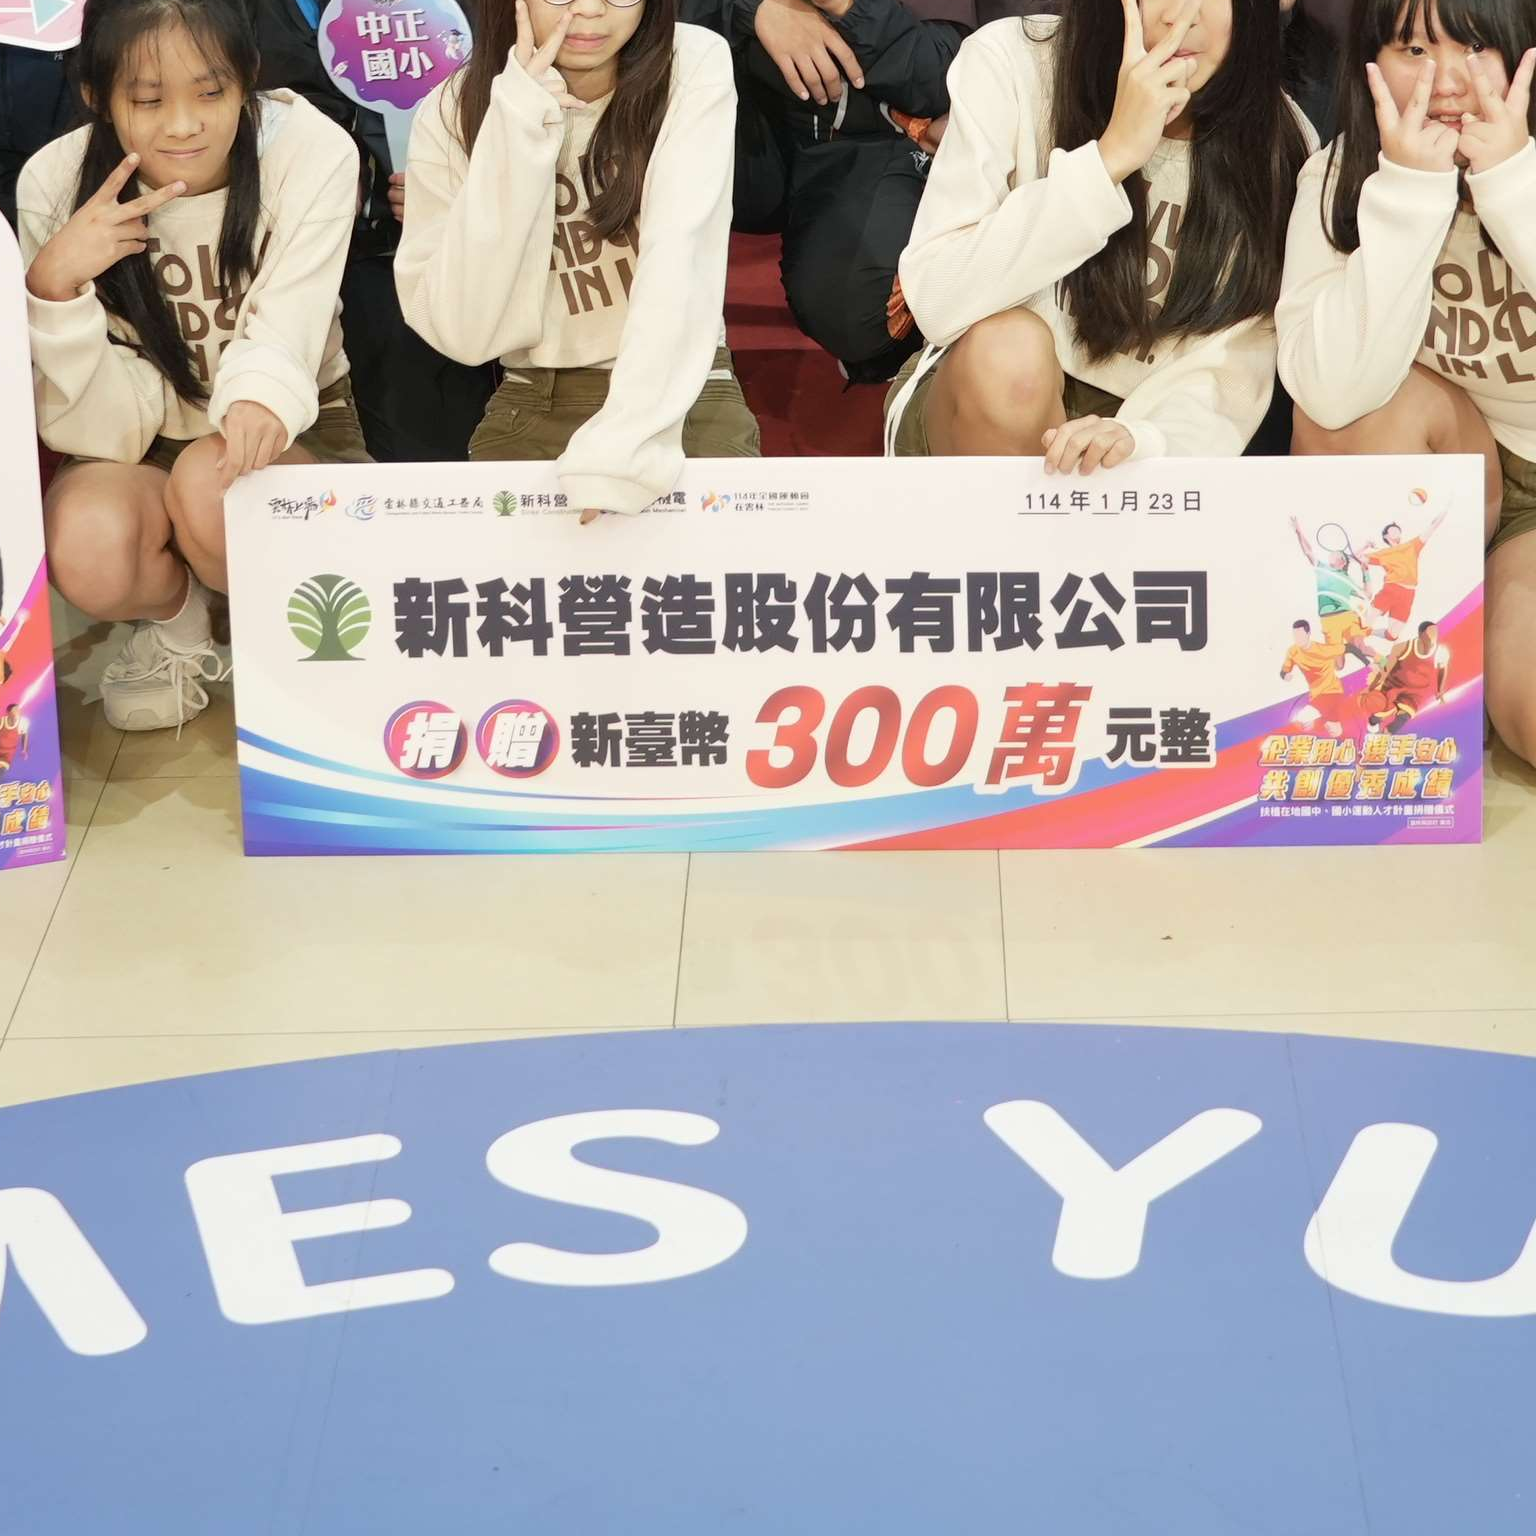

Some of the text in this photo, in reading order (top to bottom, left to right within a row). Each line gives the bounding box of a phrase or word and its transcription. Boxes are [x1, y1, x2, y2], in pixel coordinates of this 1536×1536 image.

[355, 9, 430, 44] 中正
[361, 47, 434, 82] 國小
[1025, 490, 1202, 512] 114 年 1 月 23 日
[393, 570, 1208, 659] 新科營造股份有限公司
[570, 710, 730, 769] 新臺幣
[744, 681, 1093, 790] 300萬
[1106, 706, 1211, 764] 元整
